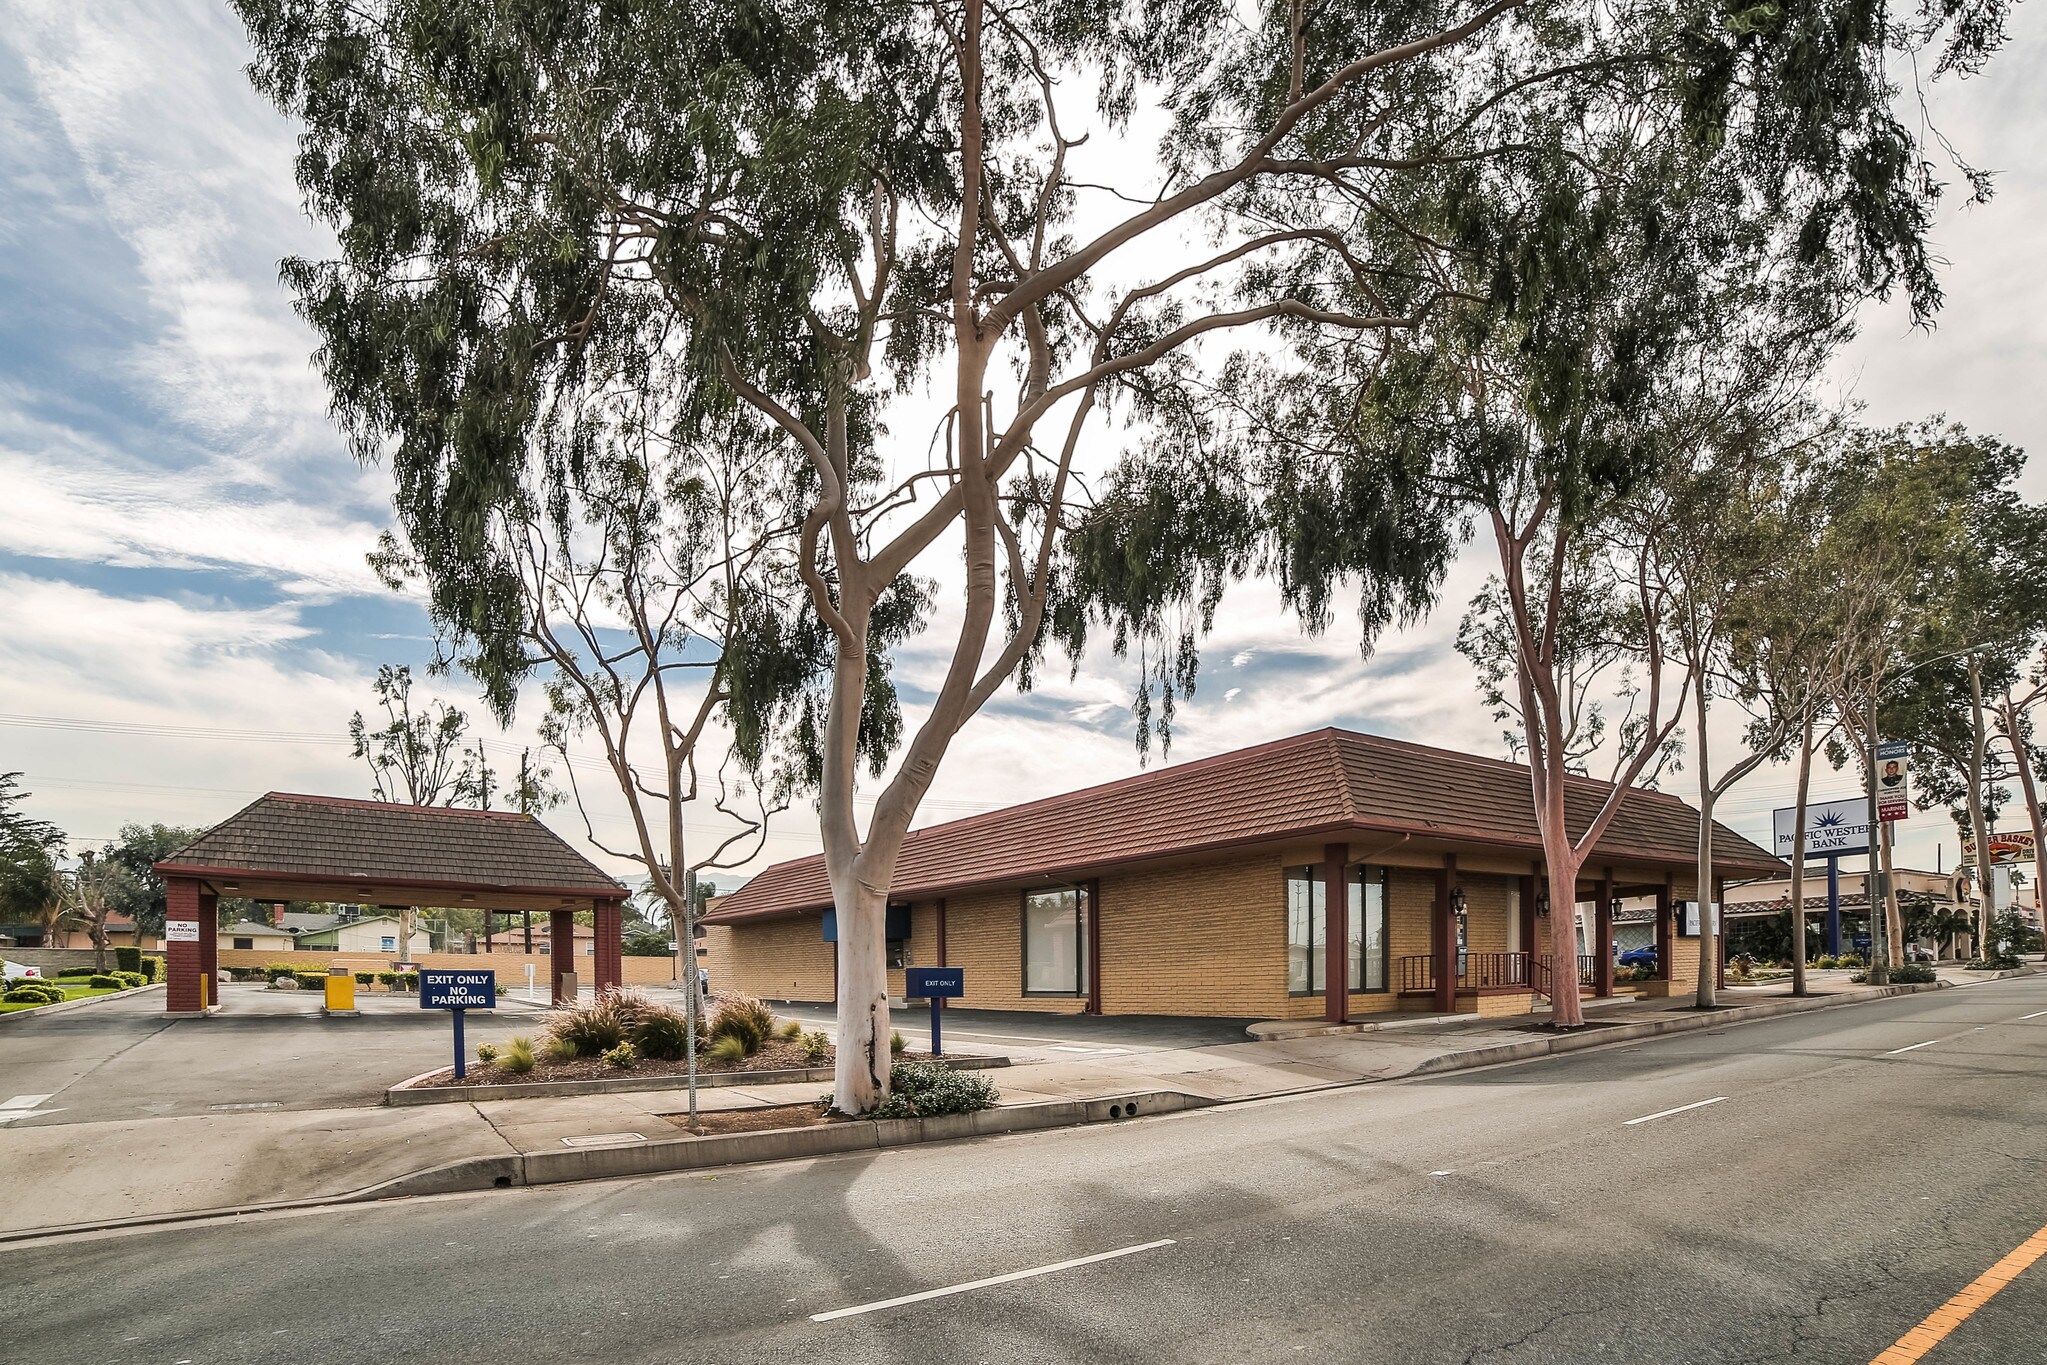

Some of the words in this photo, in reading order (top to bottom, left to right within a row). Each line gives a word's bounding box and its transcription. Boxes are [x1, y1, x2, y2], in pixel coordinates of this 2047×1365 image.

[1779, 829, 1822, 843] PAFIC
[1824, 824, 1870, 837] WESTE
[1812, 837, 1847, 848] BANK
[1964, 836, 1998, 853] BUER
[427, 976, 454, 984] EXIT
[457, 976, 488, 984] ONLY
[450, 986, 468, 995] NO
[432, 996, 486, 1004] PARKING
